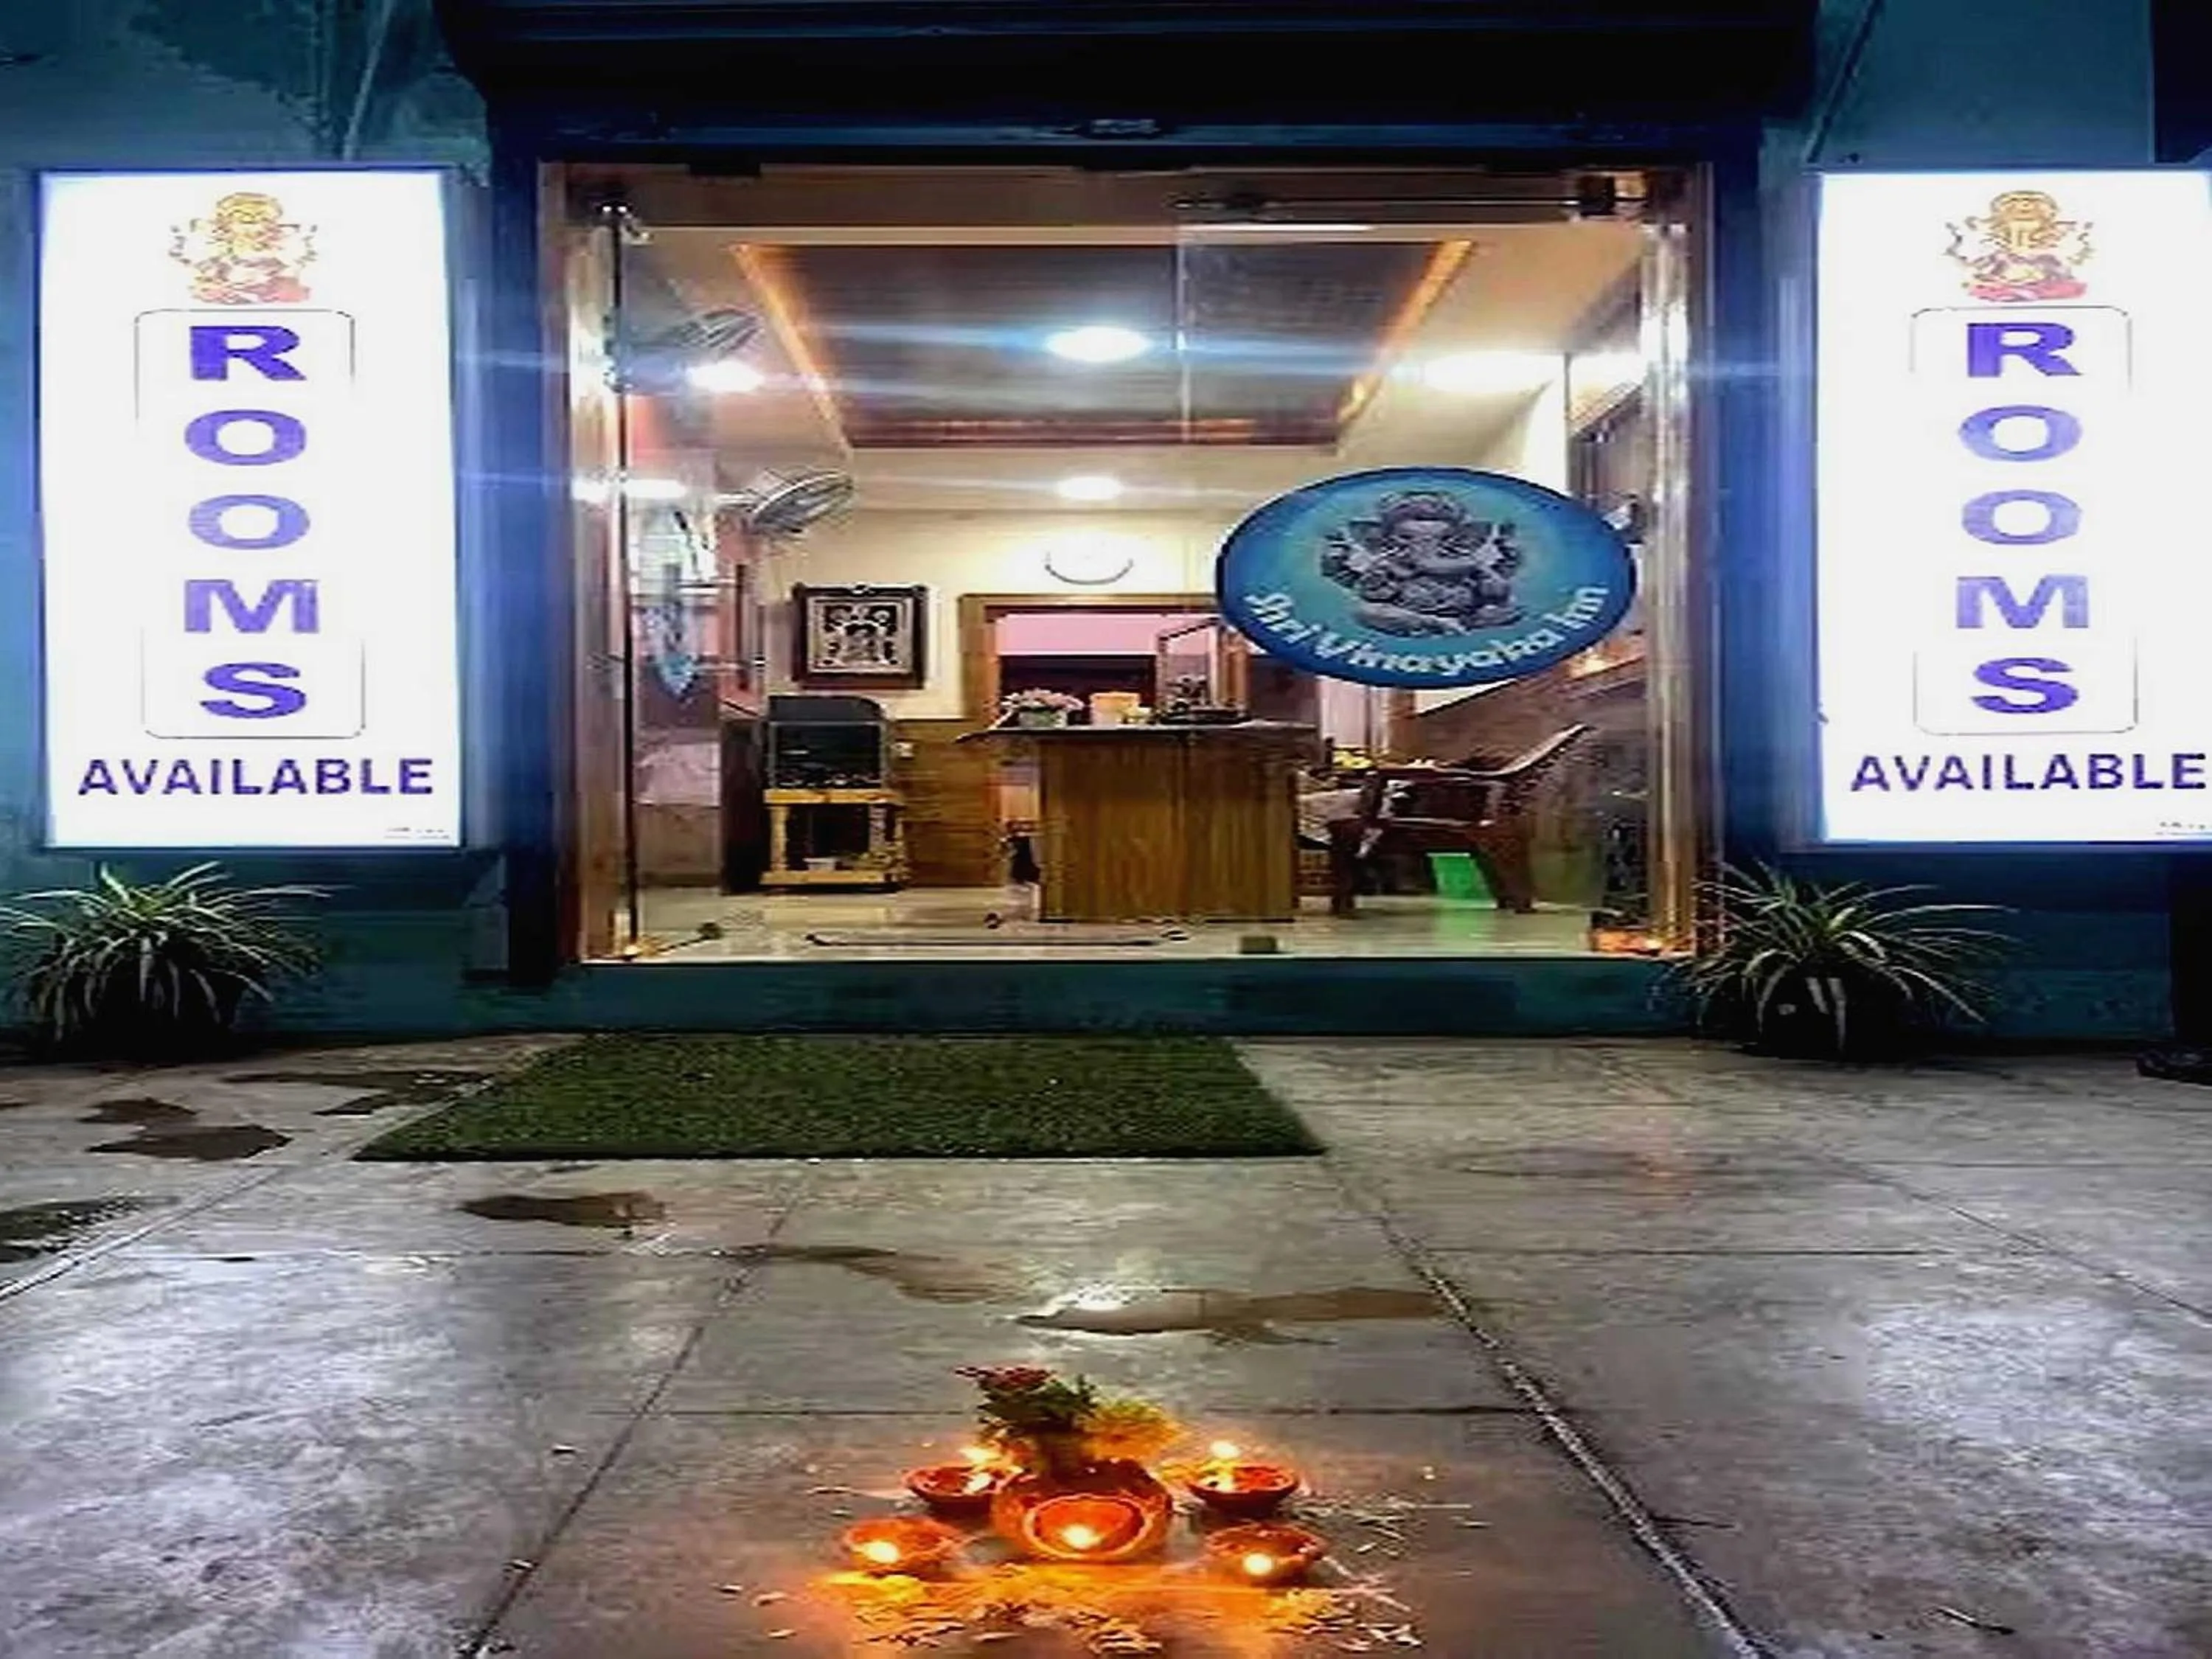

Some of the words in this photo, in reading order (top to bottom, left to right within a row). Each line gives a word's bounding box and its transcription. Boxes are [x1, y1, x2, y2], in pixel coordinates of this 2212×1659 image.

[184, 324, 319, 720] ROOMS
[1955, 321, 2089, 714] ROOMS
[1243, 592, 1322, 644] Shri
[1314, 628, 1565, 676] Vinayaka
[77, 758, 433, 796] AVAILABLE
[1850, 752, 2206, 792] AVAILABLE
